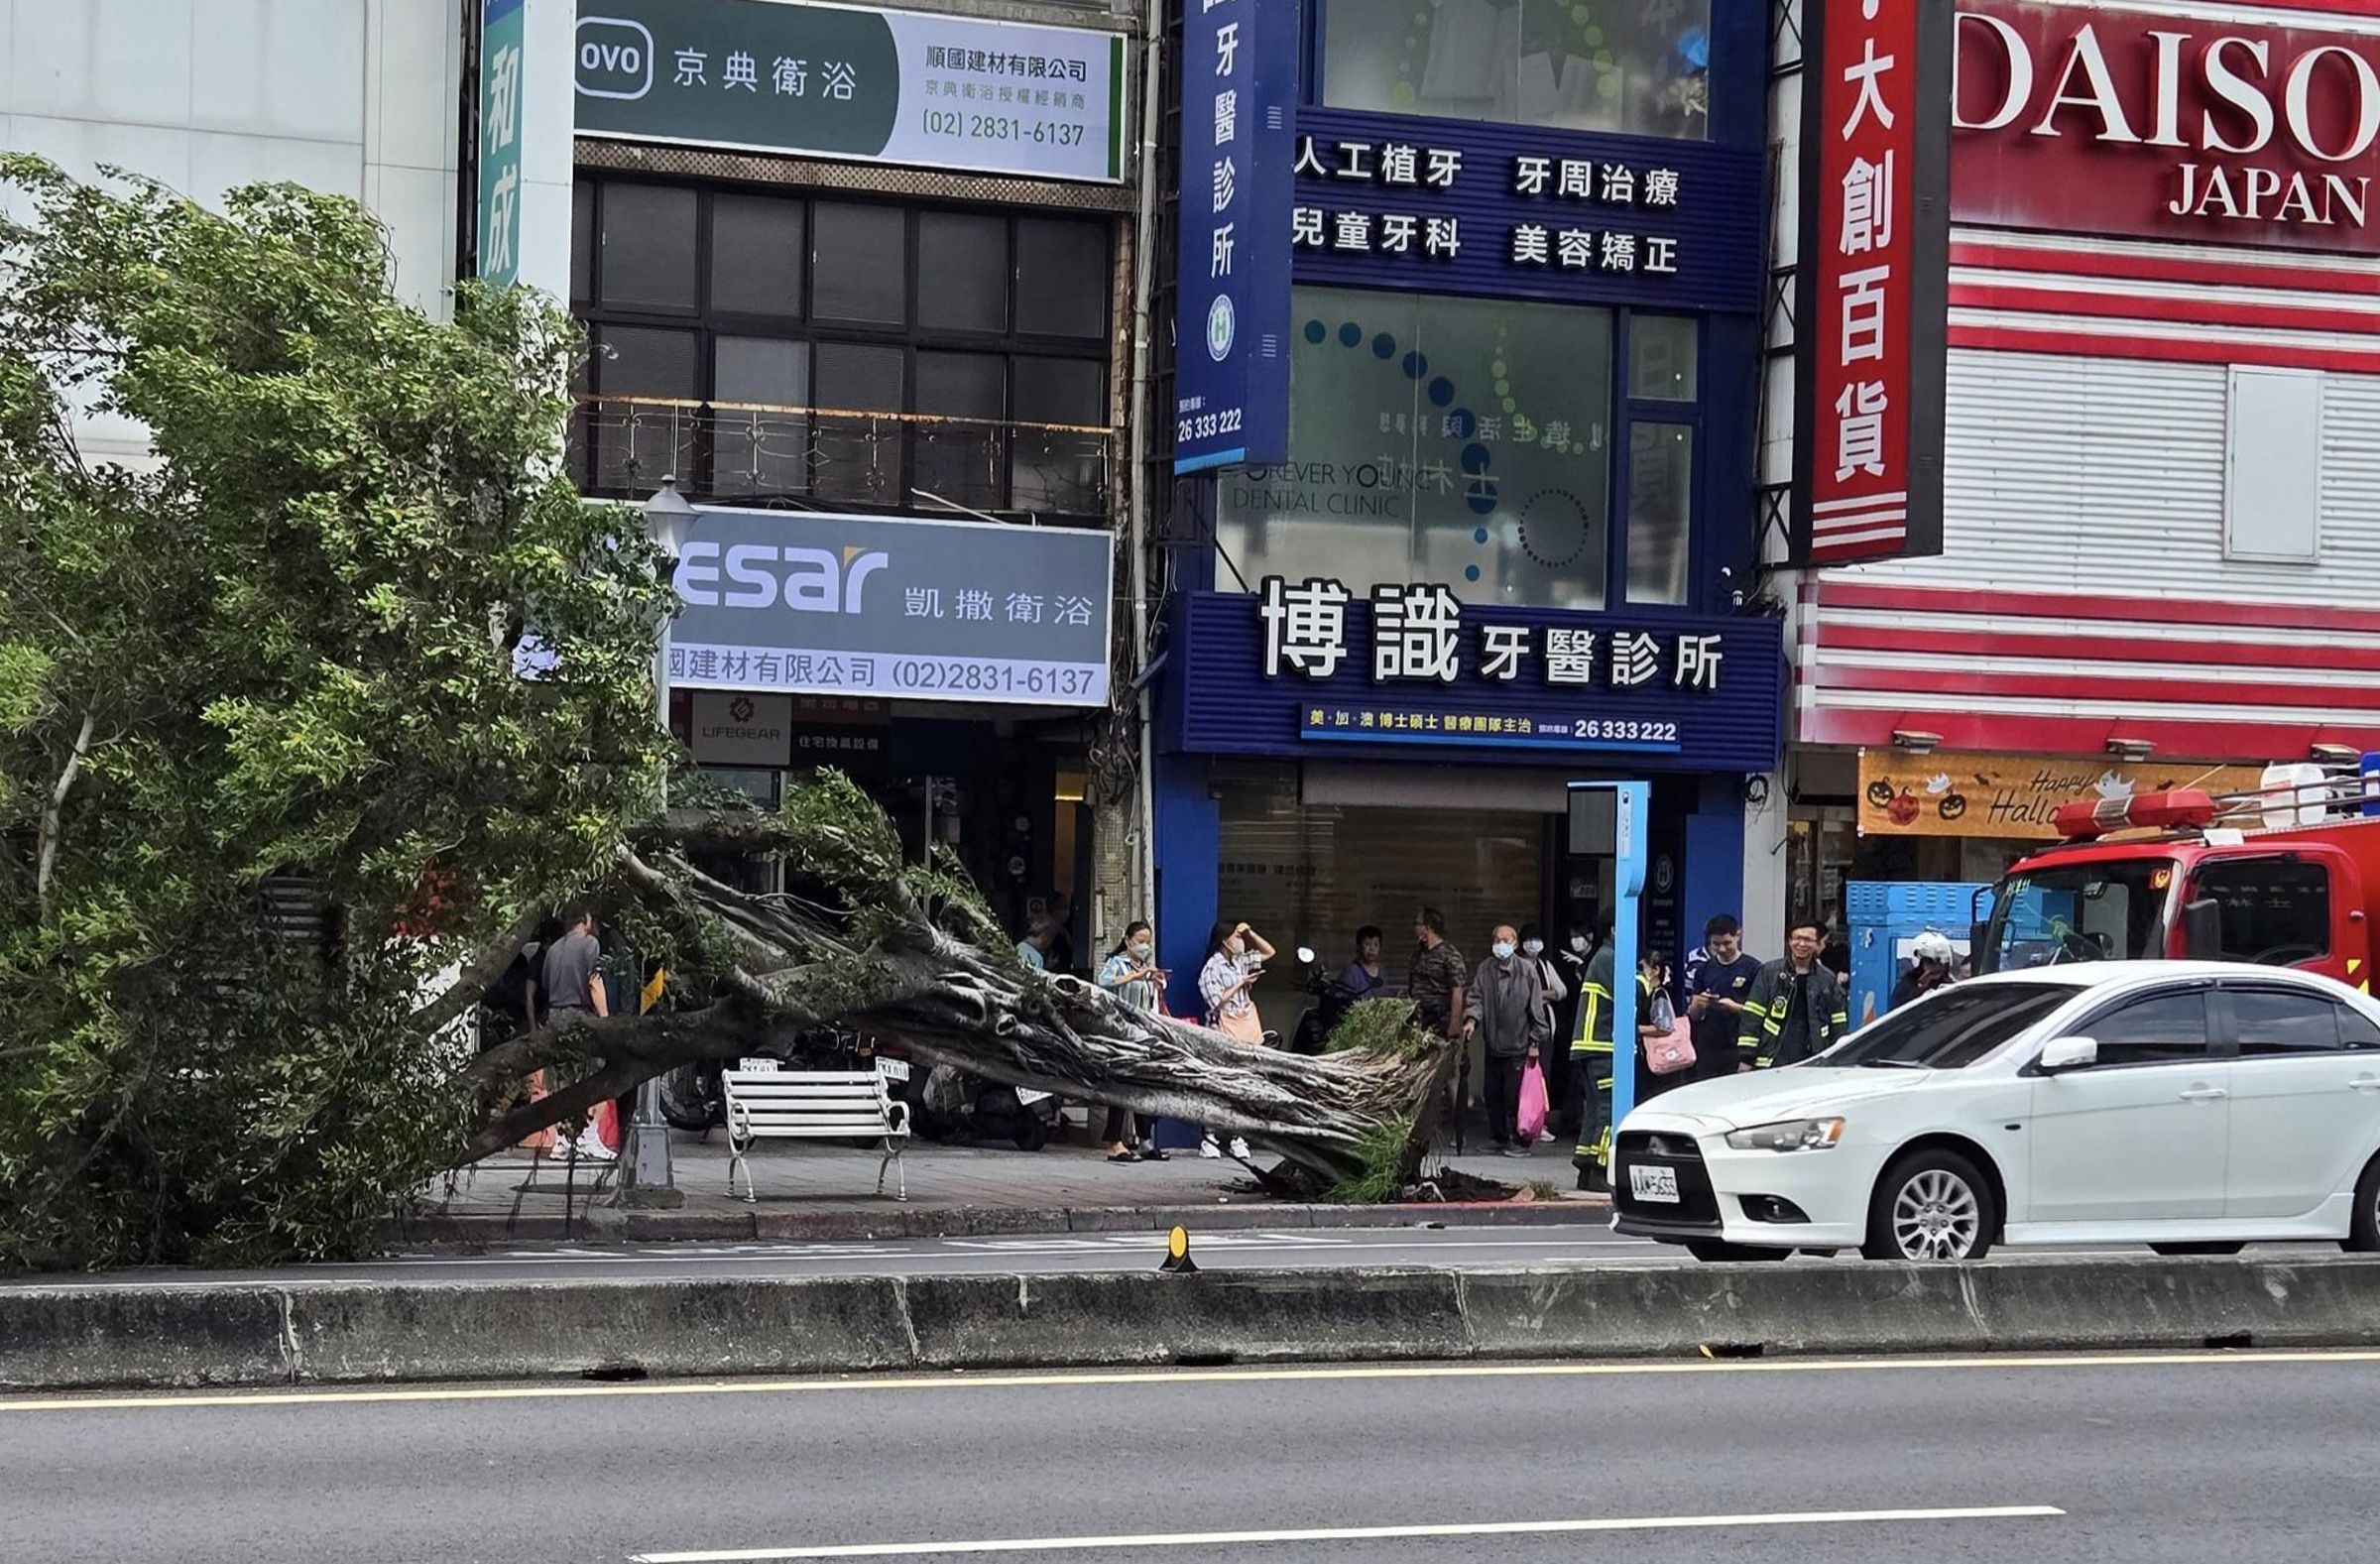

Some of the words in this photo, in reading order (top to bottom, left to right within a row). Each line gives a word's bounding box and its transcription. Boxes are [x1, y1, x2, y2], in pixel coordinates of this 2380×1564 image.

[581, 43, 641, 73] OVO
[673, 47, 856, 100] 京典衛浴
[925, 46, 1087, 82] 順國建材有限公司
[1951, 11, 2380, 162] DAISO
[971, 115, 1084, 147] 2831-6137
[1203, 0, 1239, 279] 牙醫診所
[1293, 136, 1463, 187] 人工植牙
[1516, 157, 1680, 207] 牙周治療
[2170, 164, 2370, 228] JAPAN
[1292, 207, 1462, 258] 兒童牙科
[1513, 225, 1679, 275] 美容矯正
[1835, 38, 1896, 483] 大創百貨
[1178, 419, 1192, 443] 26
[1195, 413, 1217, 439] 333
[1219, 408, 1242, 433] 222
[1234, 487, 1319, 514] DENTAL
[1328, 494, 1401, 519] CLINIC
[904, 586, 1094, 626] 凱撒衛浴
[669, 648, 875, 686] 國建材有限公司
[892, 661, 1094, 694] (02)2831-6137
[702, 726, 779, 740] LIFEGEAR
[1575, 719, 1599, 738] 26
[1602, 720, 1638, 739] 333
[1641, 722, 1677, 741] 222
[2029, 770, 2094, 795] Happy
[1987, 789, 2063, 824] Hallo
